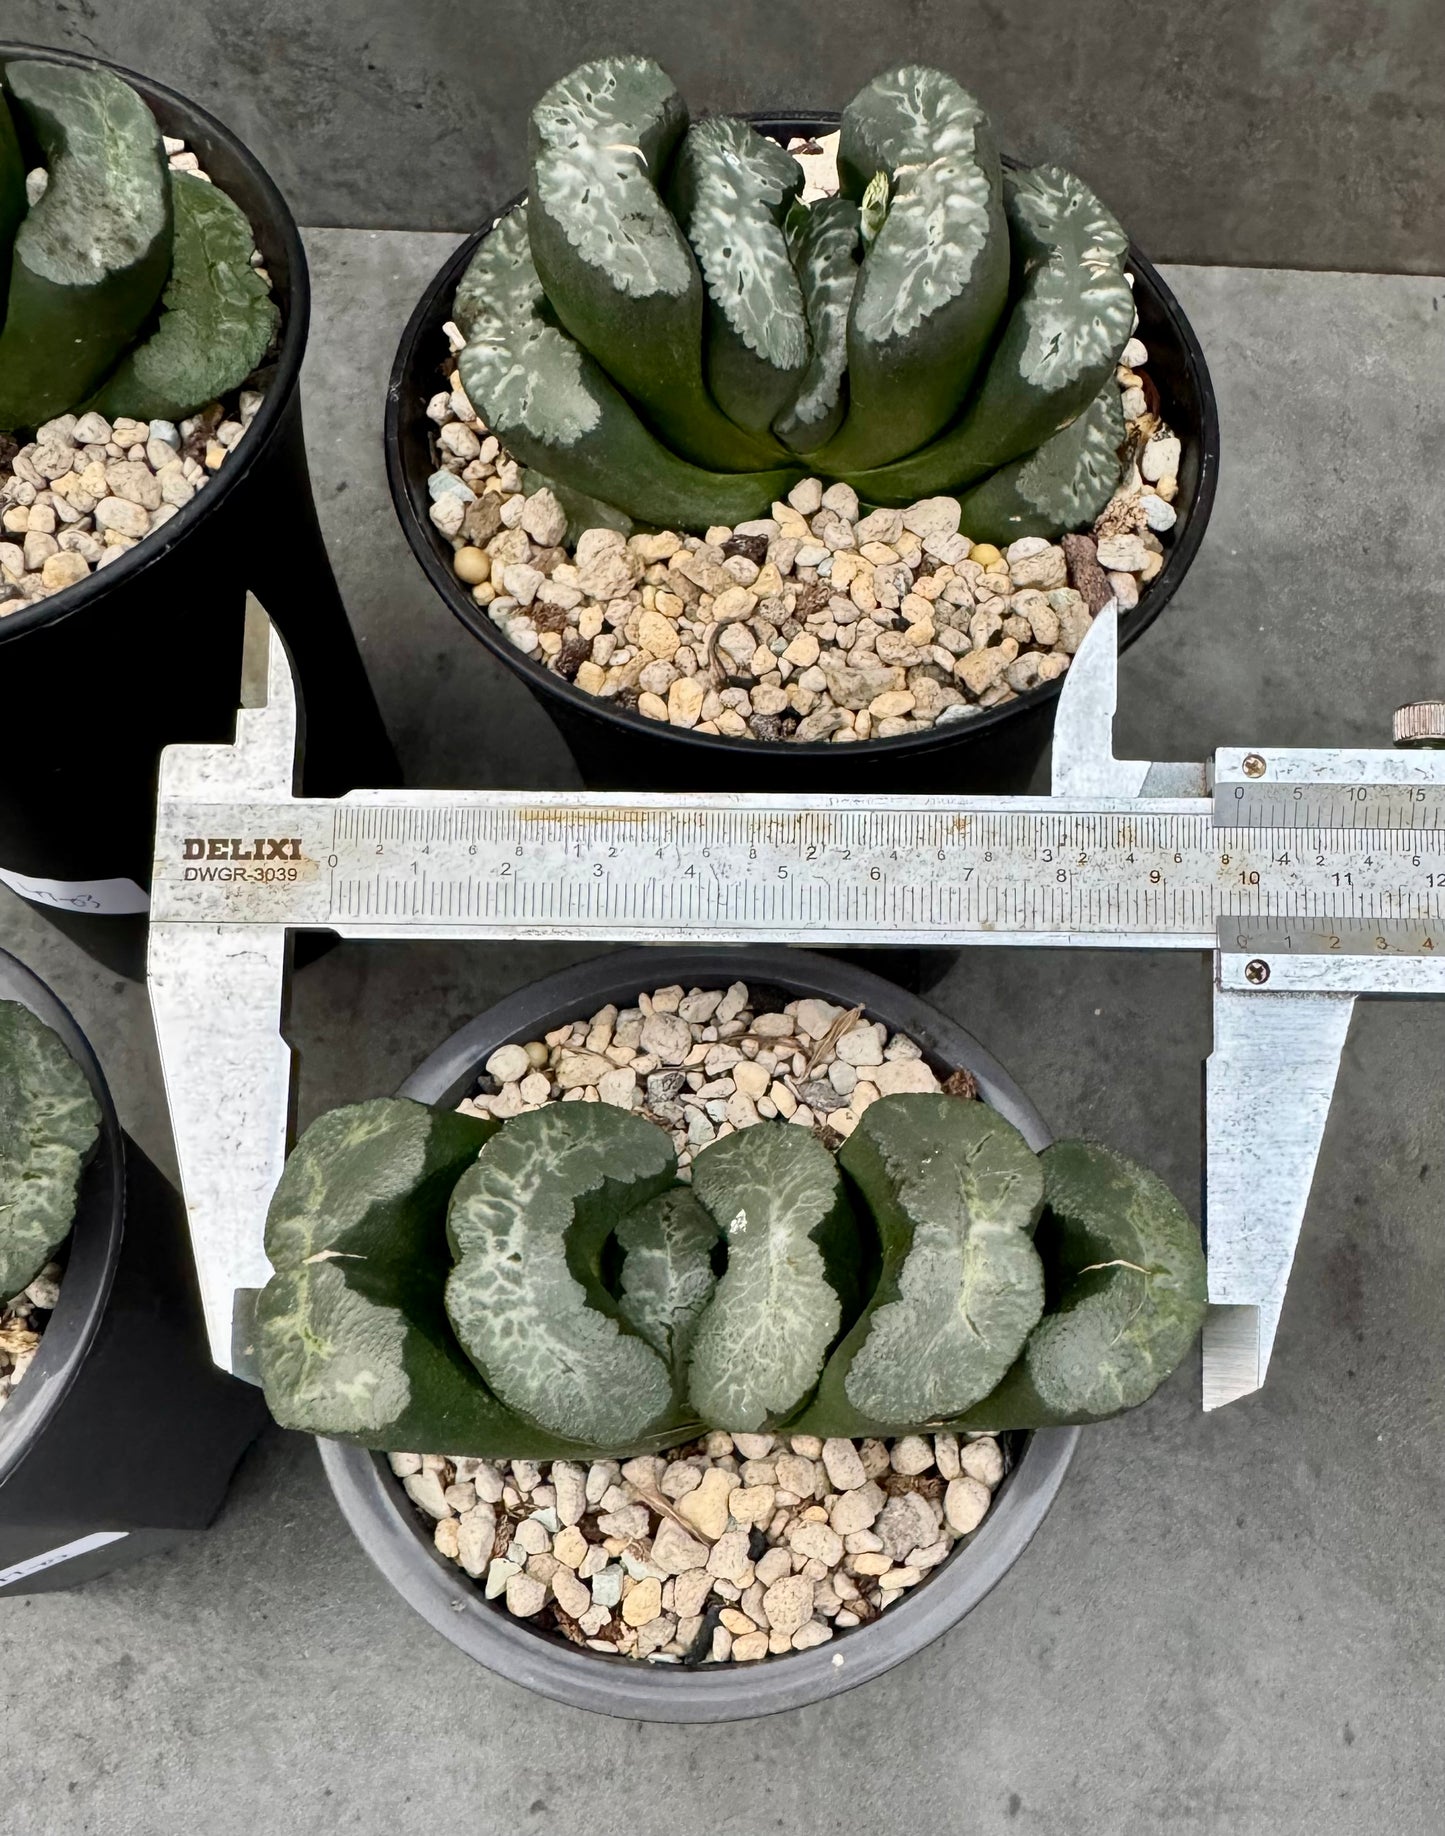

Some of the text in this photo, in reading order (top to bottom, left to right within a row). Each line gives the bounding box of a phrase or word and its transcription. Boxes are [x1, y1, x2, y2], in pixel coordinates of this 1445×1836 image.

[1234, 786, 1426, 802] 0 5 10 15
[182, 838, 303, 860] DELIXI
[375, 844, 1421, 867] 2 4 6 8 1 2 4 6 8 2 2 4 6 8 3 2 4 6 8 4 2 4 6
[184, 867, 298, 882] DWGR-3039
[327, 854, 1445, 888] 0 1 2 3 4 5 6 7 8 9 10 11 12
[1236, 934, 1434, 950] 0 1 2 3 4
